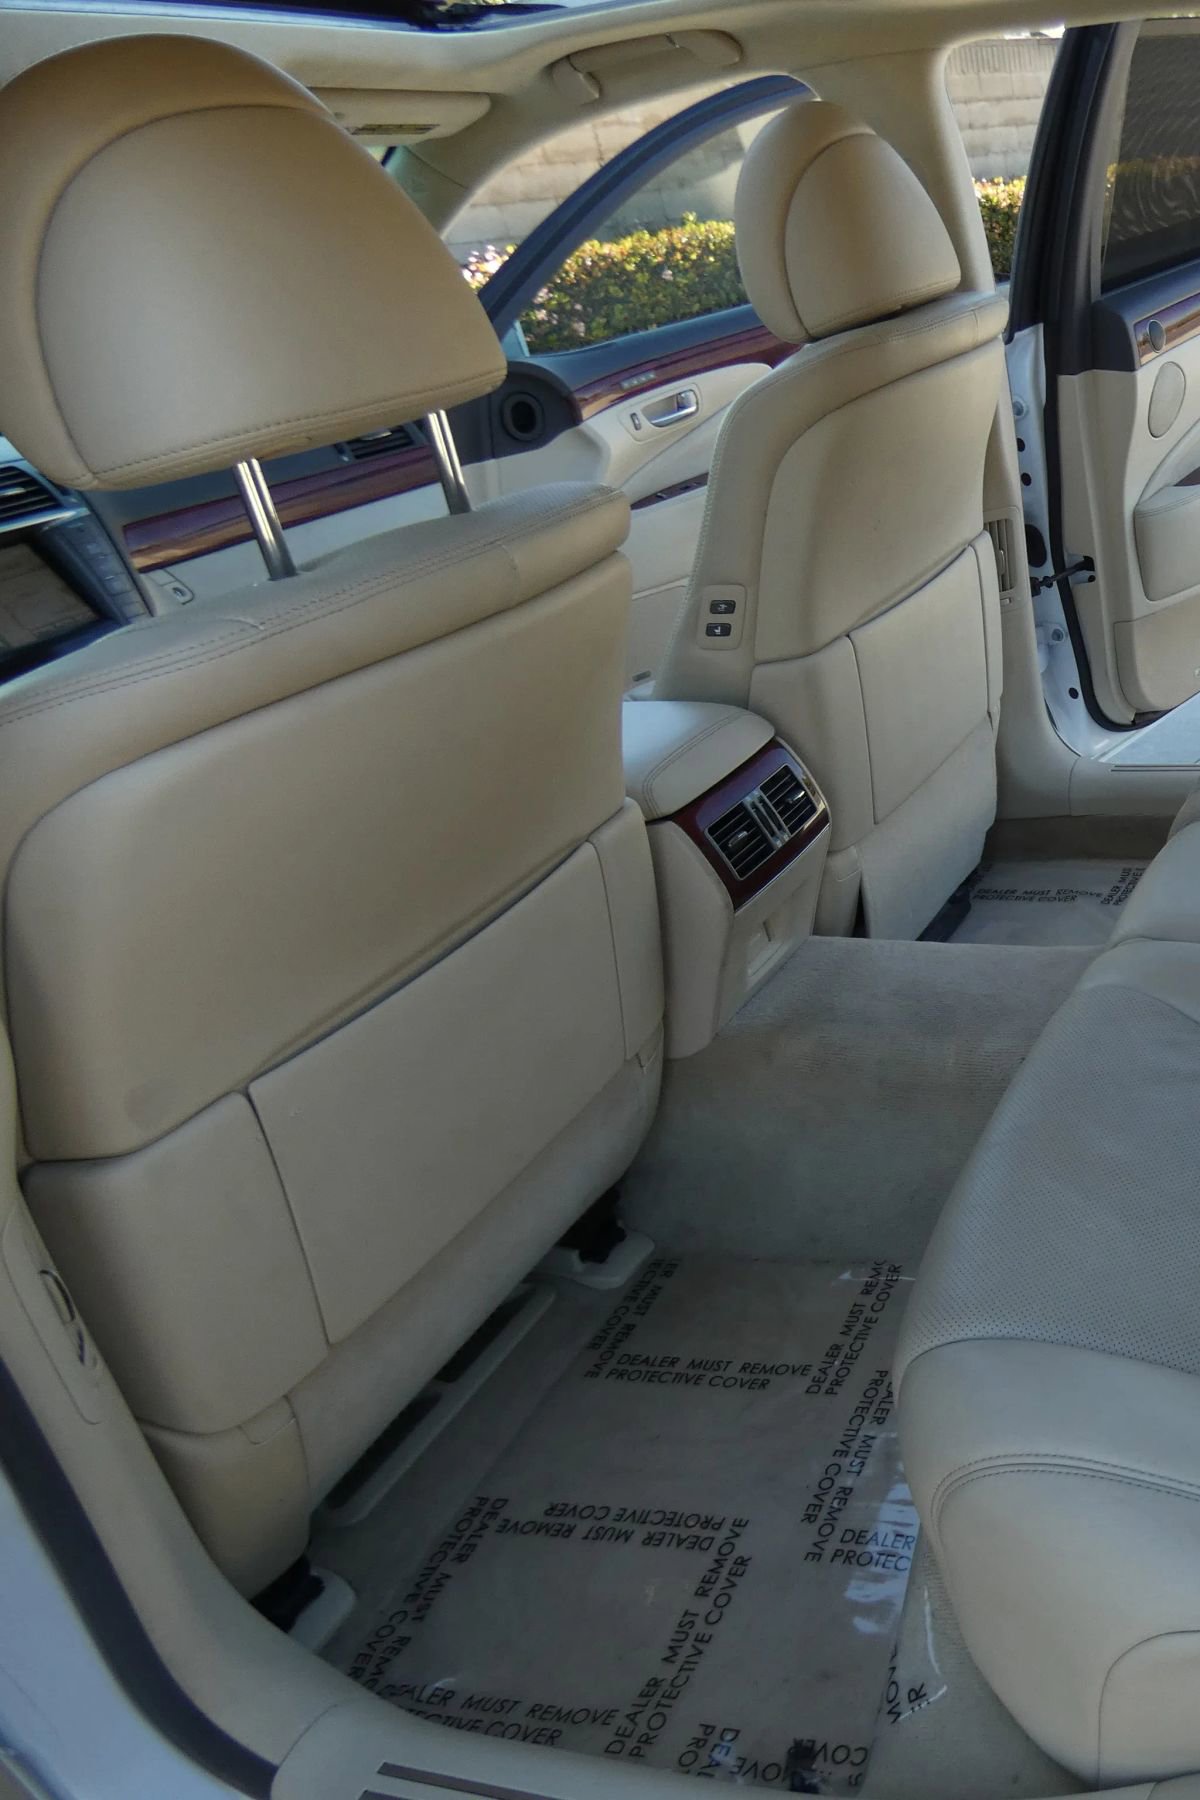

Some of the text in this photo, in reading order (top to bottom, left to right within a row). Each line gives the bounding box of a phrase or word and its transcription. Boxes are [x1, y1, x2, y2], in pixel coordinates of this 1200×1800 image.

[972, 894, 1078, 903] PROTECTIVE COVER
[977, 888, 1103, 899] DEALER MUST REMOVE
[583, 1323, 637, 1379] REMOVE
[585, 1305, 630, 1351] COVER
[804, 1343, 845, 1395] DEALER
[840, 1302, 867, 1336] MUST
[824, 1264, 903, 1396] PROTECTIVE COVER
[605, 1367, 772, 1391] PROTECTIVE COVER
[619, 1353, 814, 1378] DEALER MUST REMOVE
[800, 1369, 889, 1525] PROTECTIVE COVER
[846, 1434, 878, 1477] MUST
[449, 1498, 510, 1564] DEALER
[495, 1519, 715, 1552] DEALER MUST REMOVE
[543, 1500, 725, 1531] PROTECTIVE COVER
[803, 1486, 854, 1563] REMOVE
[831, 1548, 912, 1572] PROTEC
[840, 1528, 916, 1551] DEALER
[347, 1496, 490, 1679] PROTECTIVE COVER
[411, 1572, 453, 1623] MUST
[603, 1517, 751, 1757] DEALER MUST REMOVE
[628, 1554, 752, 1760] PROTECTIVE COVER
[460, 1694, 523, 1715] MUST
[525, 1703, 621, 1726] REMOVE
[485, 1720, 565, 1747] COVER
[677, 1723, 717, 1774] PRO
